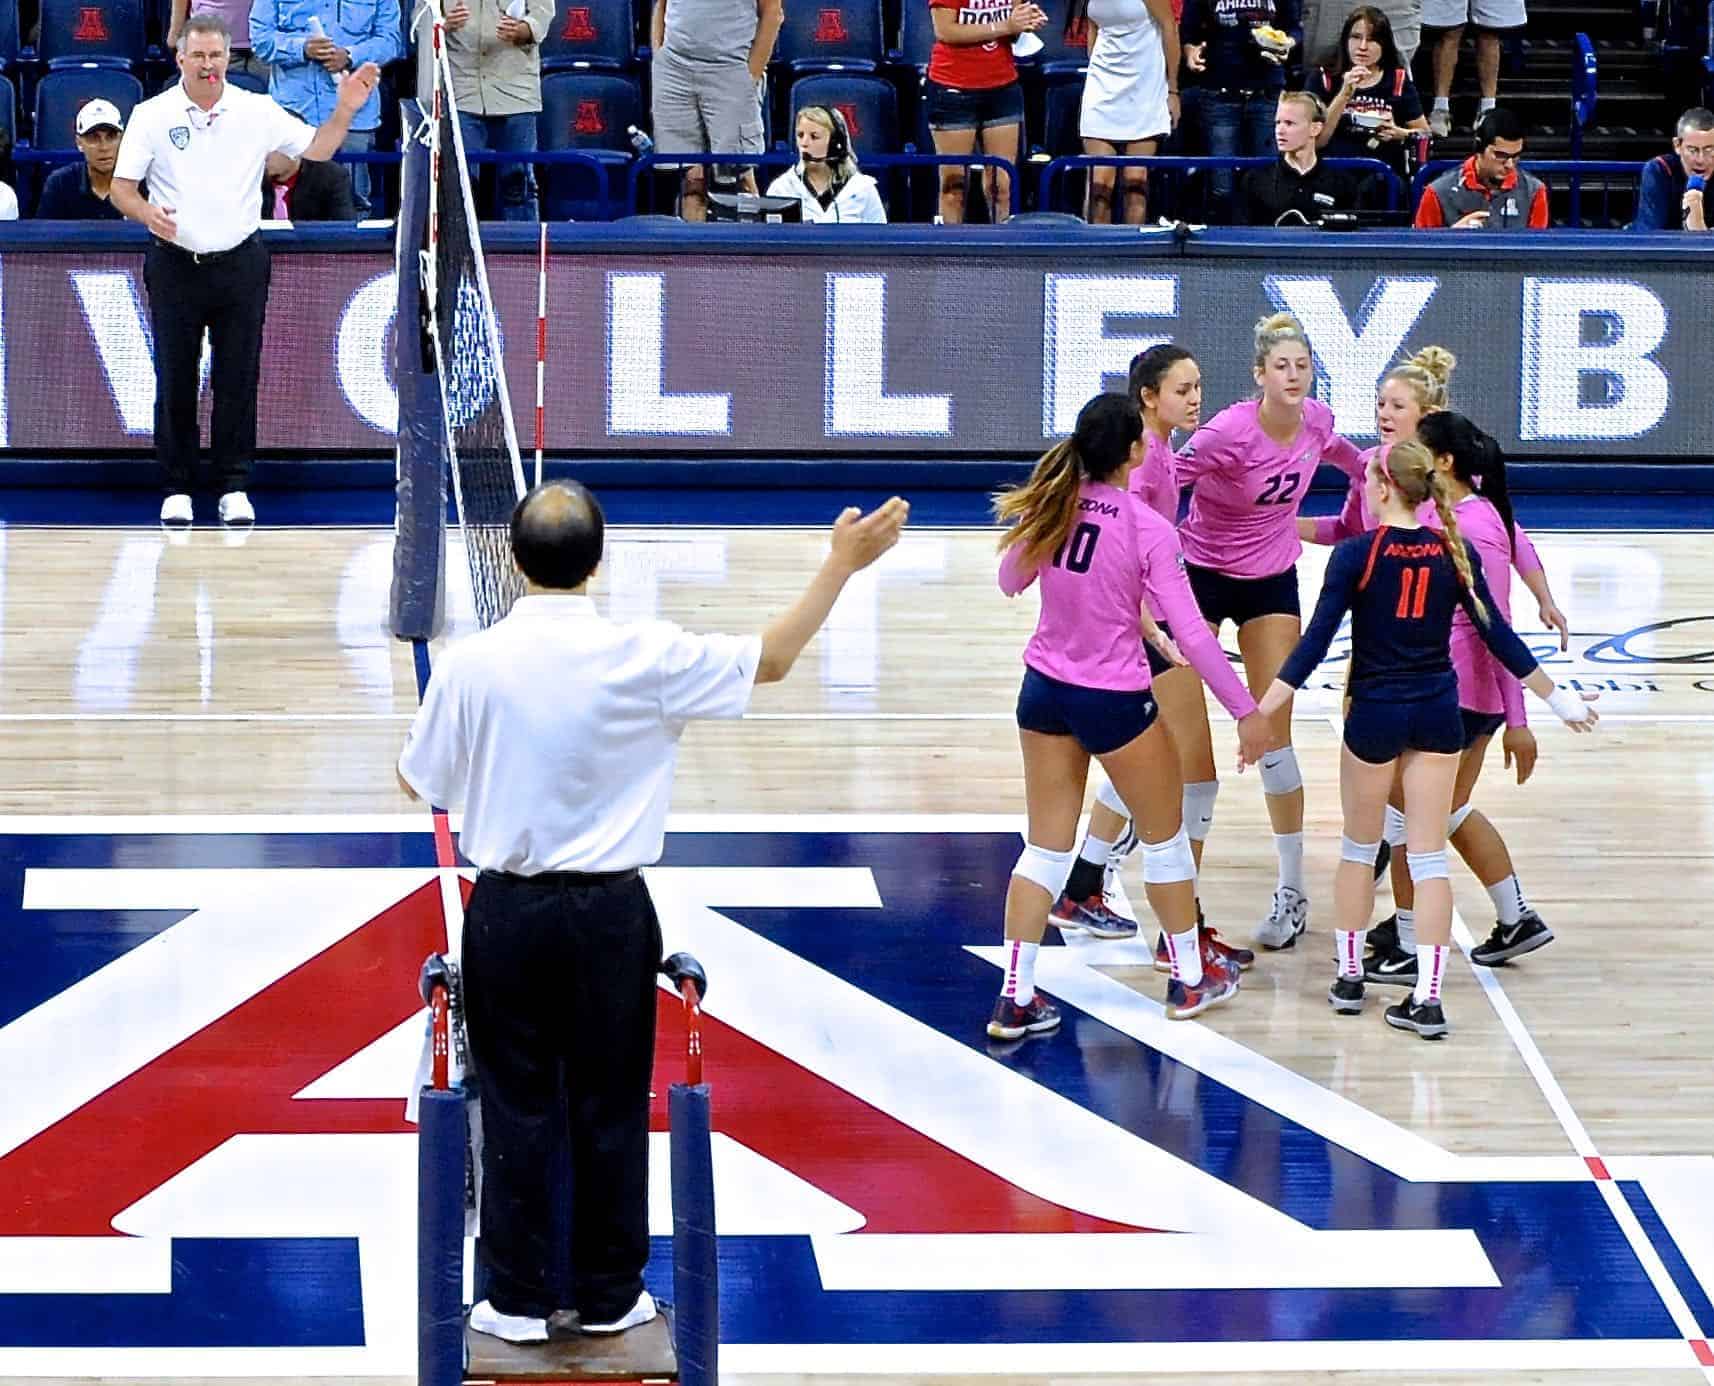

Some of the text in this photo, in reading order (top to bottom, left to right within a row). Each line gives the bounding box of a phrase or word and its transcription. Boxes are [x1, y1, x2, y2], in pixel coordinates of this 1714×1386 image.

[1255, 471, 1301, 506] 22
[1078, 498, 1119, 518] ZONA
[1052, 522, 1101, 574] 10
[1384, 543, 1444, 558] ARIZONA
[1396, 566, 1430, 619] 11
